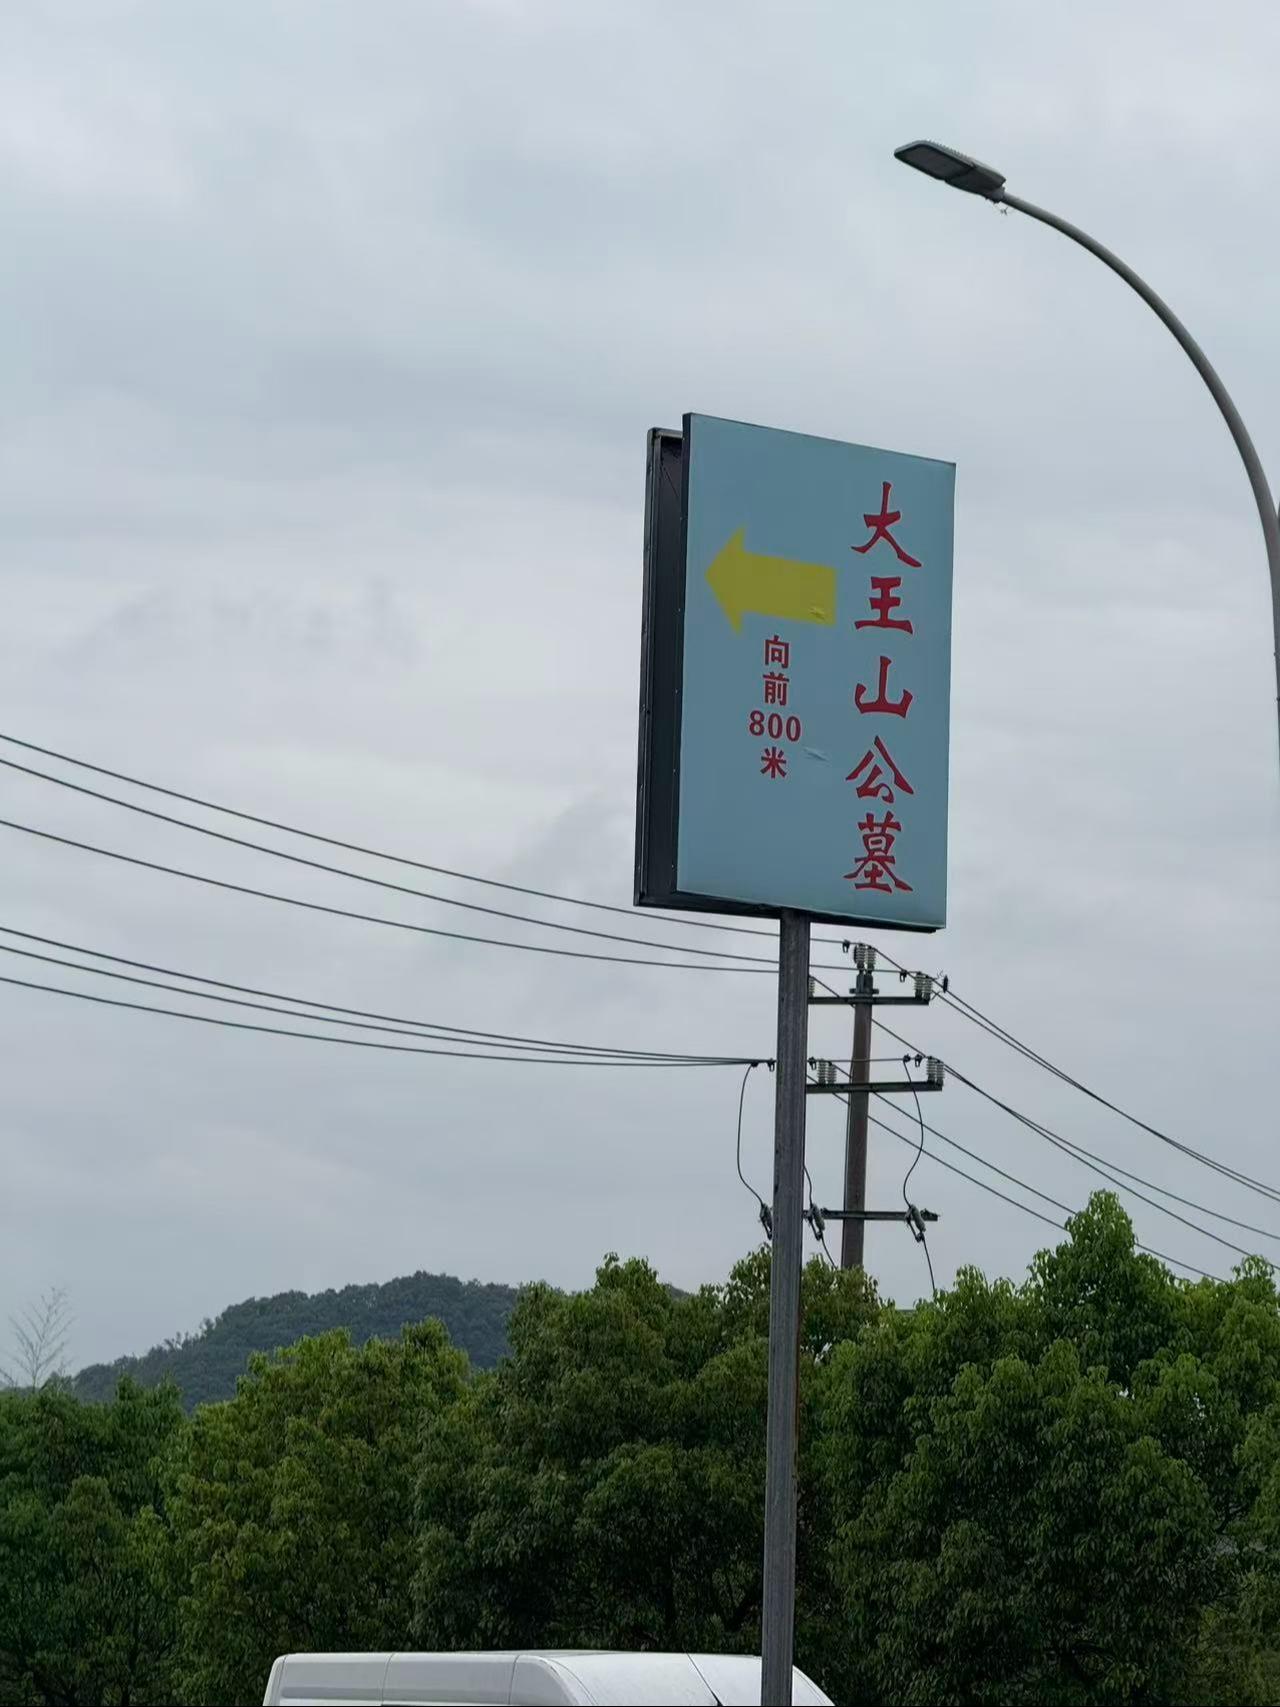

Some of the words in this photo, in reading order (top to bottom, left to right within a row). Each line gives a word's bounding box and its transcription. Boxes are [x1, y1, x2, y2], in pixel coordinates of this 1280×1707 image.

[843, 481, 922, 893] 大王山公墓
